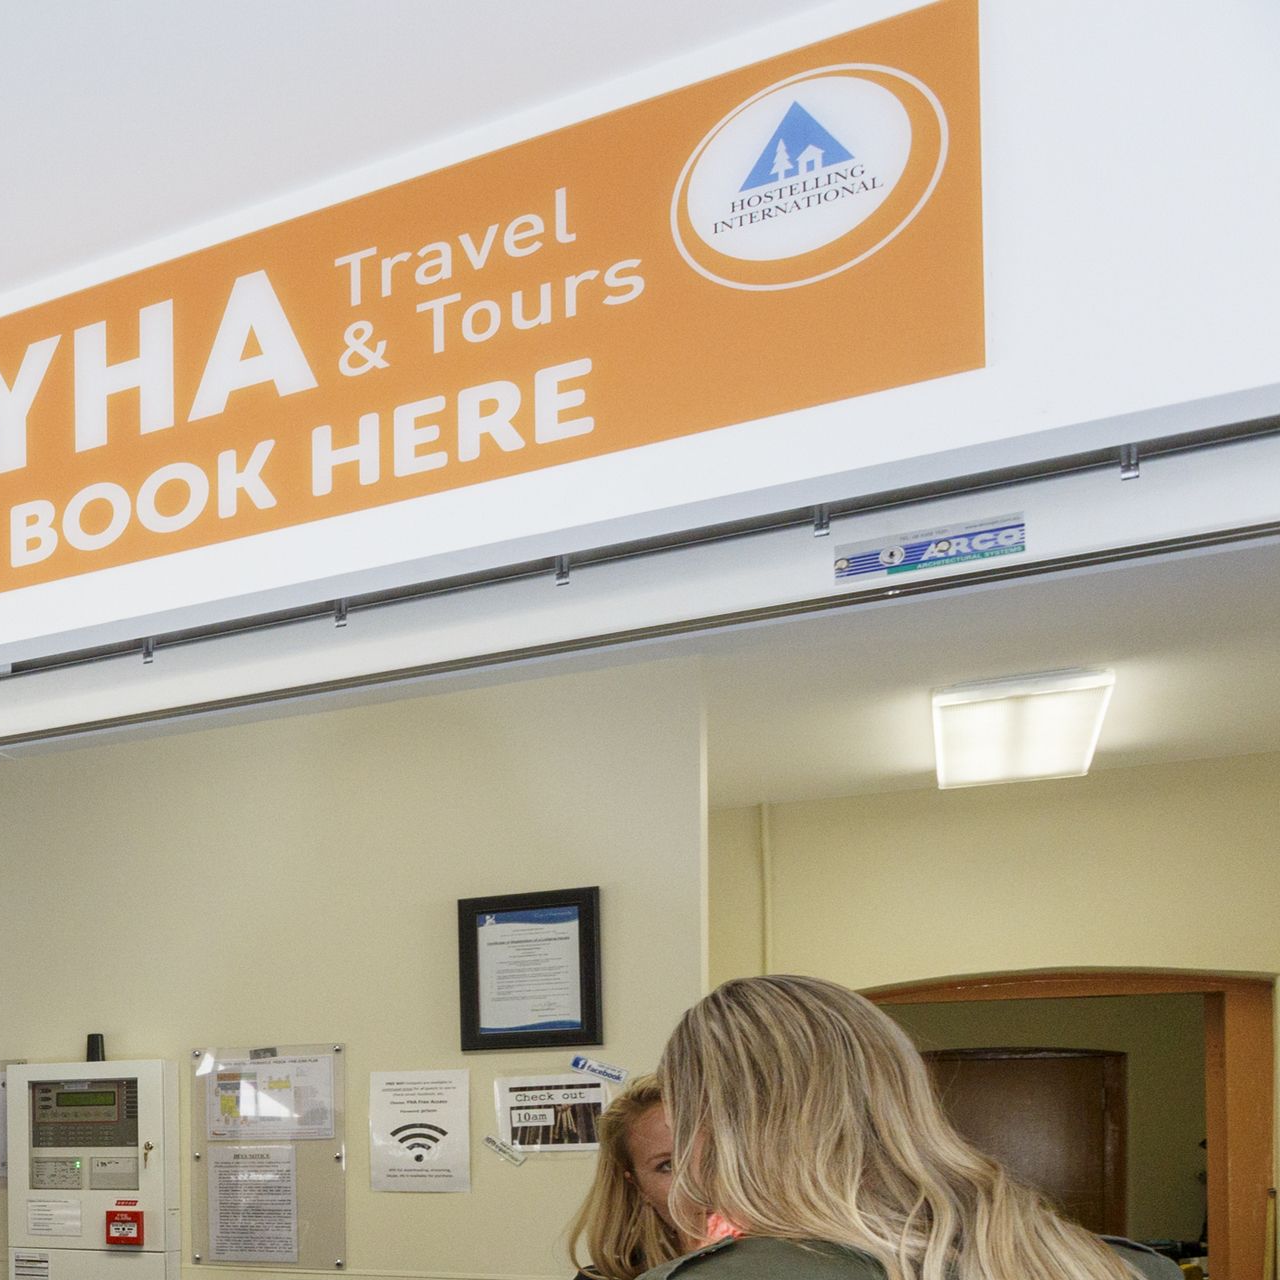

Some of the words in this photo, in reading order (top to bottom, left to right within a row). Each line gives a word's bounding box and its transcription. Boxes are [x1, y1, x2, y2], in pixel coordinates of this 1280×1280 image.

[713, 177, 884, 234] INTERNATIONAL
[731, 164, 865, 213] HOSTELLING
[334, 187, 576, 310] Travel
[337, 319, 389, 379] &
[416, 258, 646, 357] Tours
[11, 438, 276, 569] BOOK
[310, 357, 596, 497] HERE
[916, 552, 981, 570] ARCHITECTURAL
[984, 546, 1023, 559] SYSTEMS
[921, 528, 1023, 561] ARCO
[586, 1064, 623, 1082] facebook
[515, 1092, 555, 1103] Check
[561, 1091, 585, 1101] out
[516, 1111, 548, 1123] 10am
